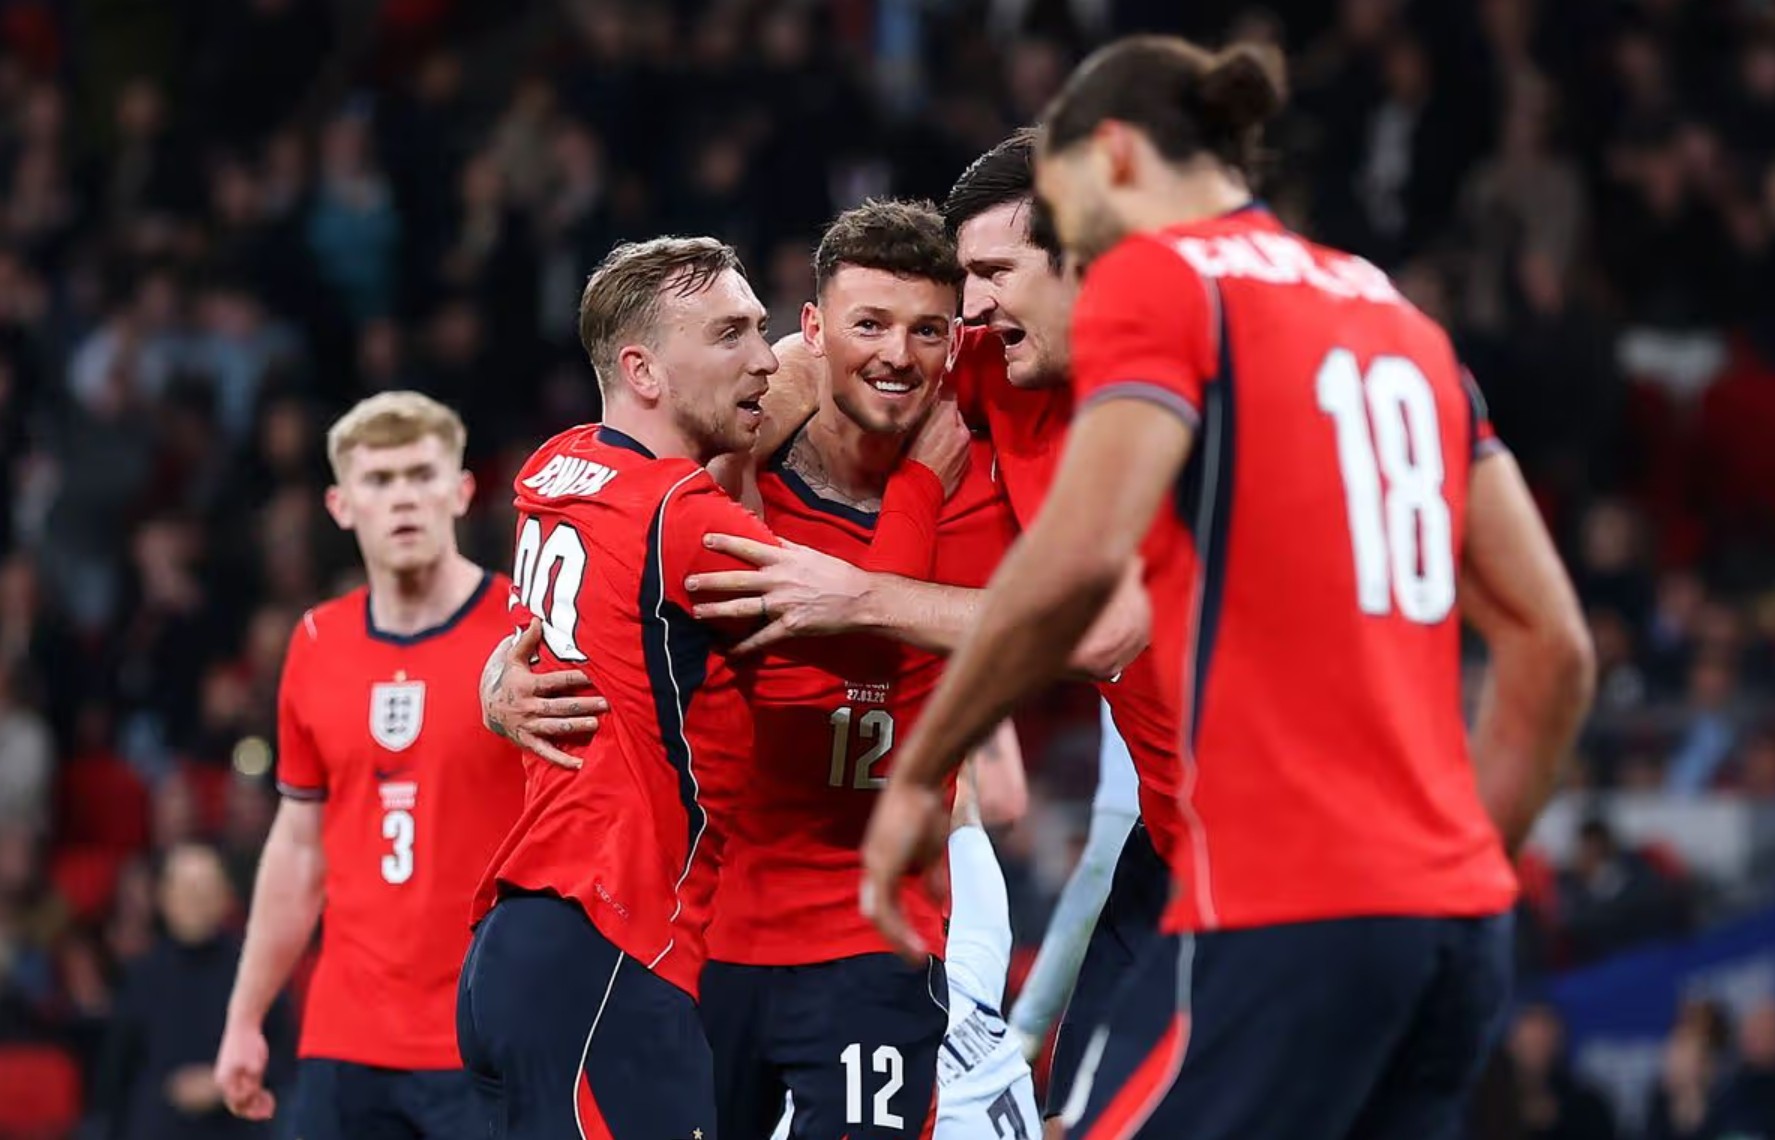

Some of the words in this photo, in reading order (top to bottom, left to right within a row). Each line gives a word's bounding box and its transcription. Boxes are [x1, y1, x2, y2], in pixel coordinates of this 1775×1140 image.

[1315, 347, 1456, 625] 18
[829, 706, 894, 789] 12
[380, 809, 415, 884] 3
[839, 1042, 905, 1130] 12
